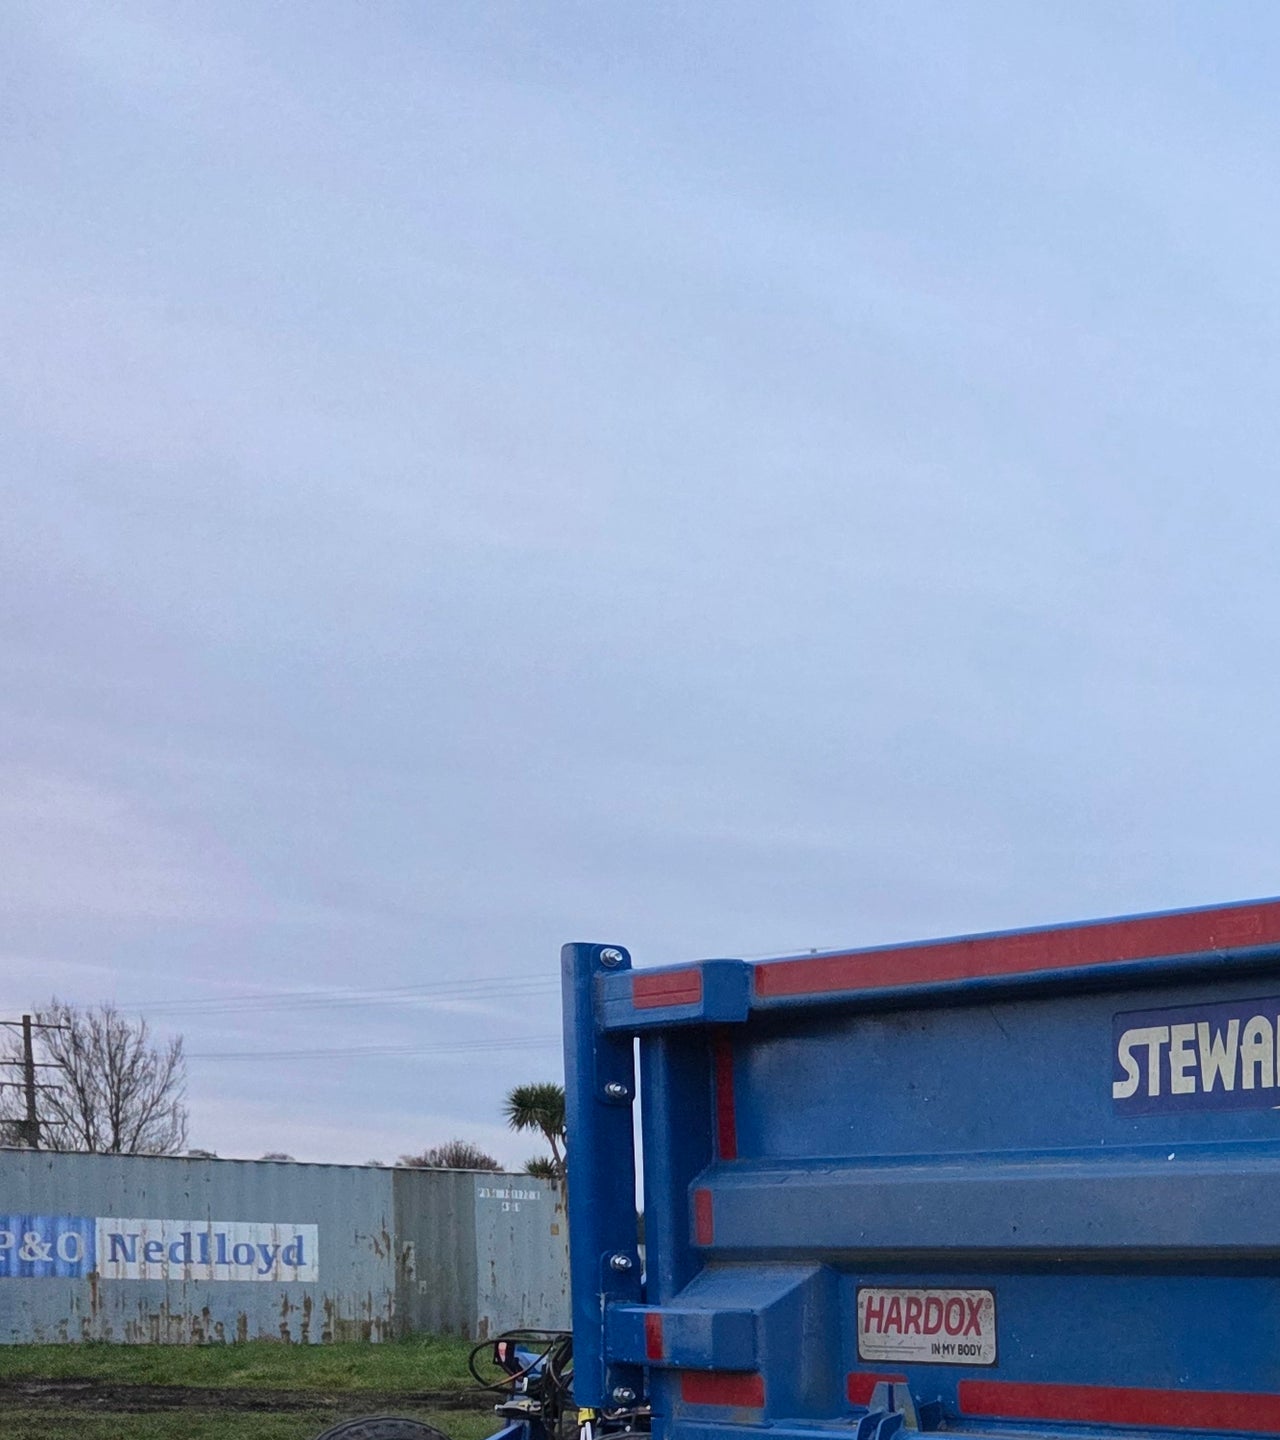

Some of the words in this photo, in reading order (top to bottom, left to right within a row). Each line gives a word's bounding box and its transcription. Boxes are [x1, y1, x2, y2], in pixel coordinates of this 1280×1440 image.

[0, 1231, 84, 1262] P&O
[107, 1231, 306, 1272] Nedlloyd
[864, 1295, 985, 1336] HARDOX
[931, 1343, 941, 1355] IN
[942, 1344, 955, 1356] MY
[957, 1344, 982, 1357] BODY
